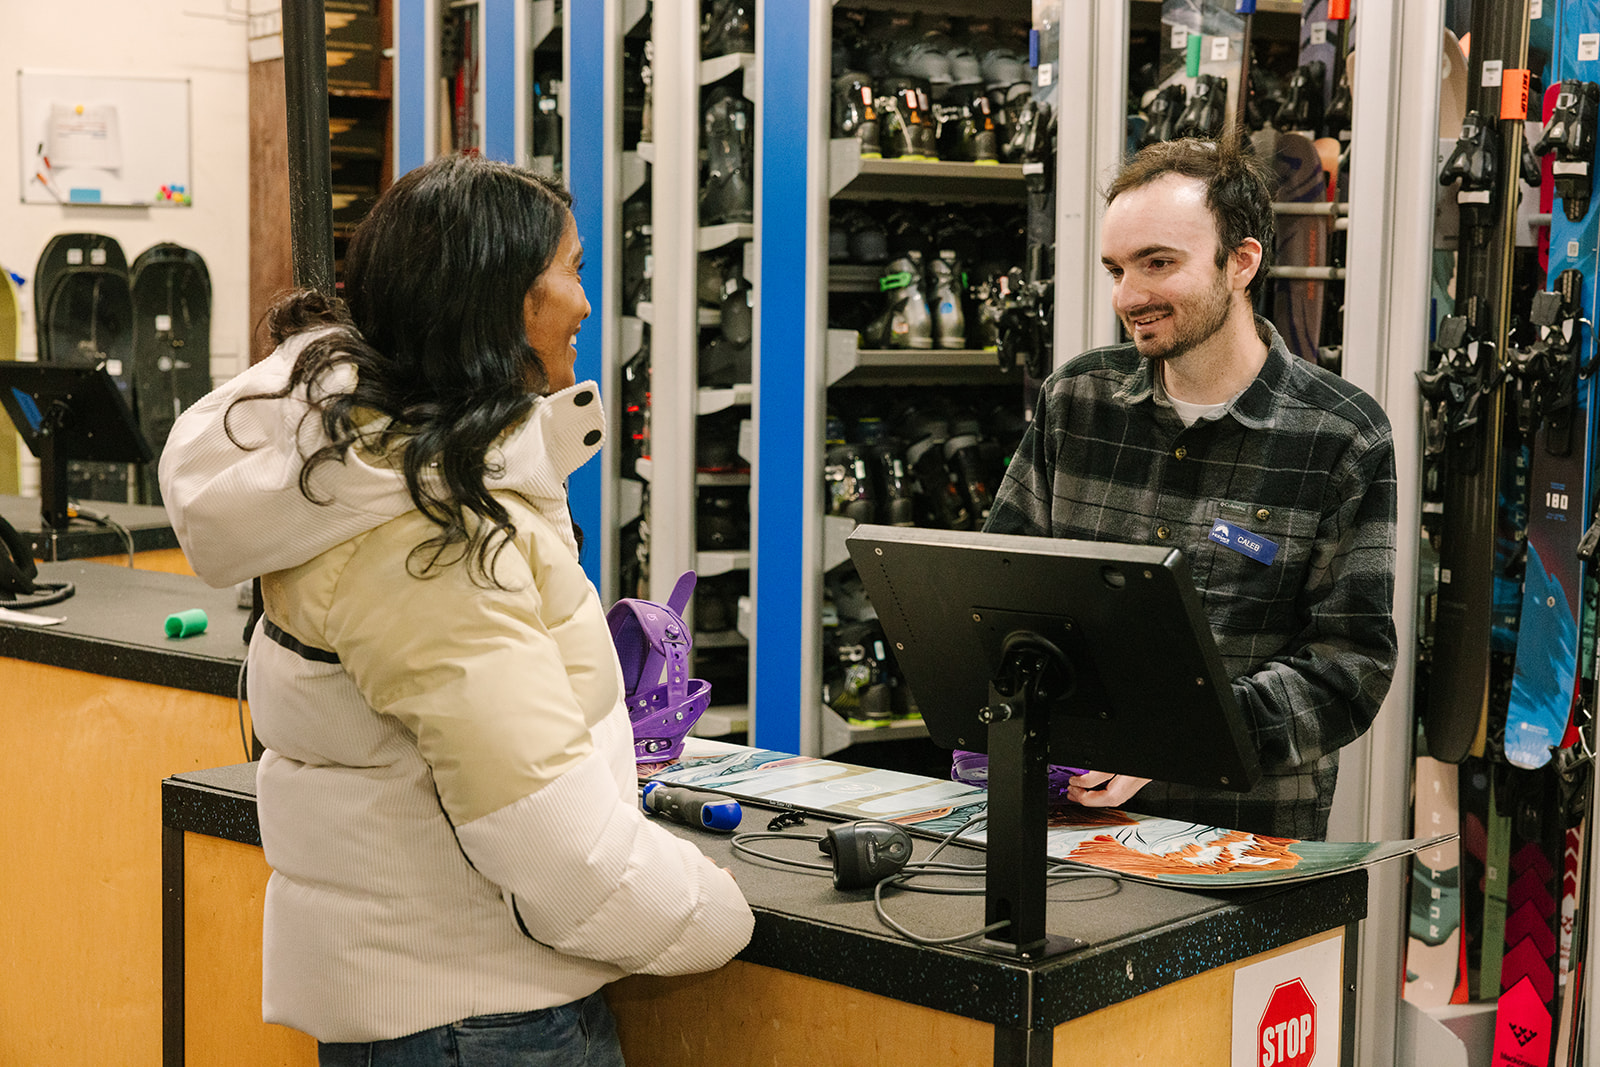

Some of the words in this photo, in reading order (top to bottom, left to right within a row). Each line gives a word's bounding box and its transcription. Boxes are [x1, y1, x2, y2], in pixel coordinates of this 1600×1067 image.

[1515, 456, 1526, 541] STLER
[1545, 492, 1569, 510] 180
[1237, 536, 1260, 552] CALEB
[1262, 1013, 1312, 1067] STOP
